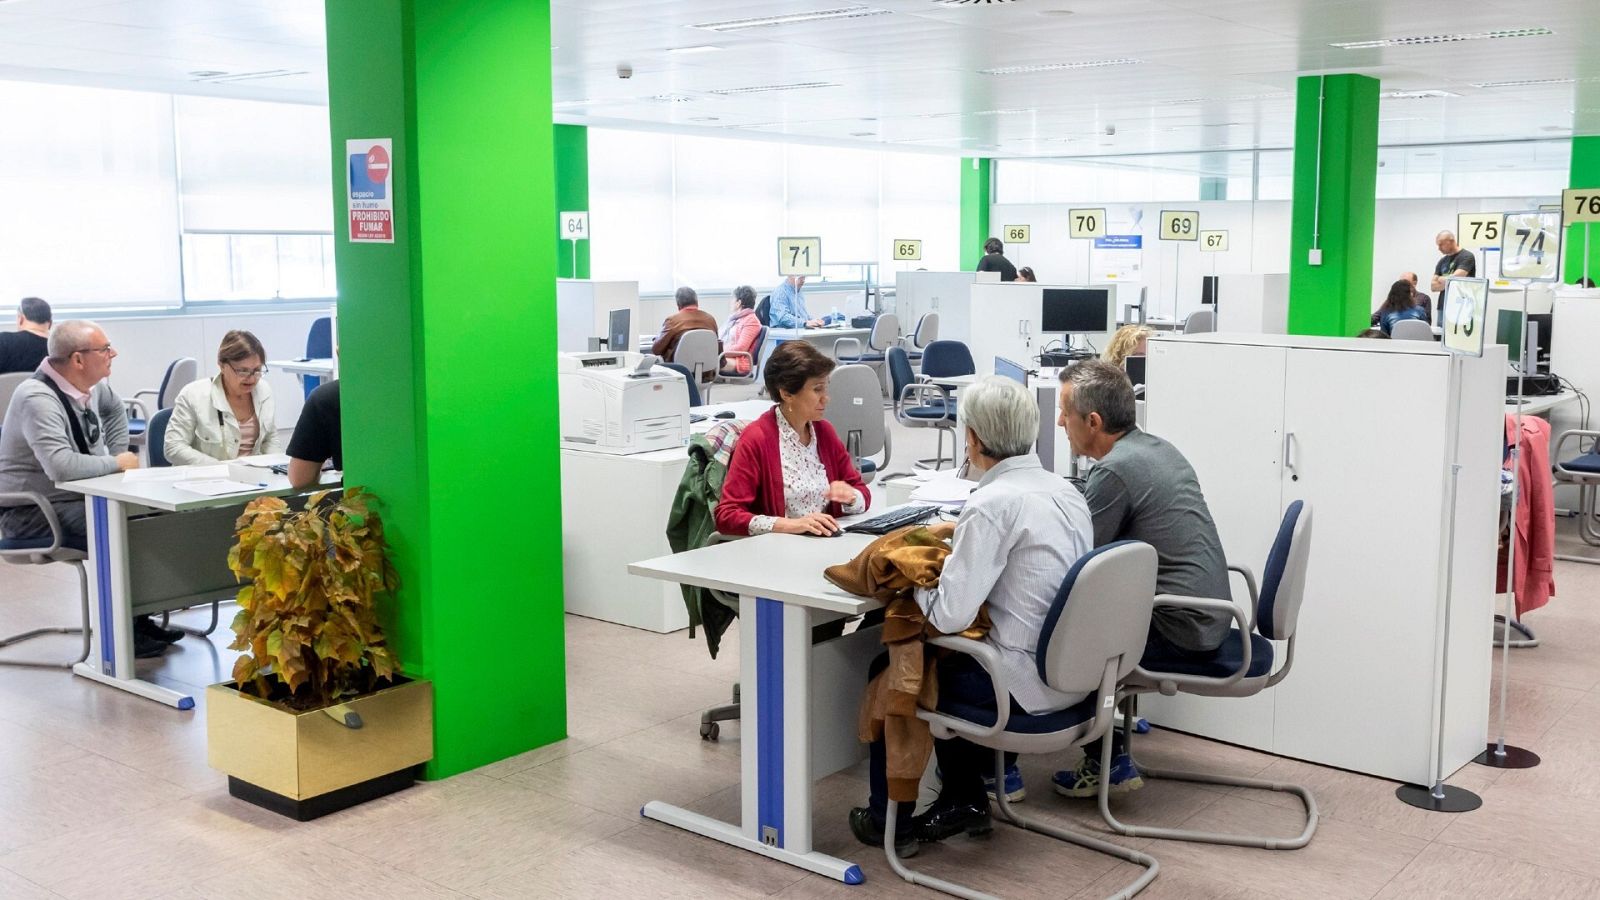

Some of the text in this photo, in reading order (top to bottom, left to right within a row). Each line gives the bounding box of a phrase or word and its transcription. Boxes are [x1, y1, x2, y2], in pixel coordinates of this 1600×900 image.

[352, 191, 374, 199] espacio
[362, 201, 379, 209] humo
[1574, 196, 1600, 214] 76
[352, 211, 390, 221] PROHIBIDO
[359, 221, 383, 232] FUMAR
[568, 218, 583, 232] 64
[1076, 216, 1096, 232] 70
[1171, 217, 1191, 234] 69
[1470, 221, 1498, 240] 75
[1010, 229, 1024, 239] 66
[1207, 235, 1222, 247] 67
[1516, 228, 1545, 264] 74
[789, 245, 810, 267] 71
[899, 244, 915, 256] 65
